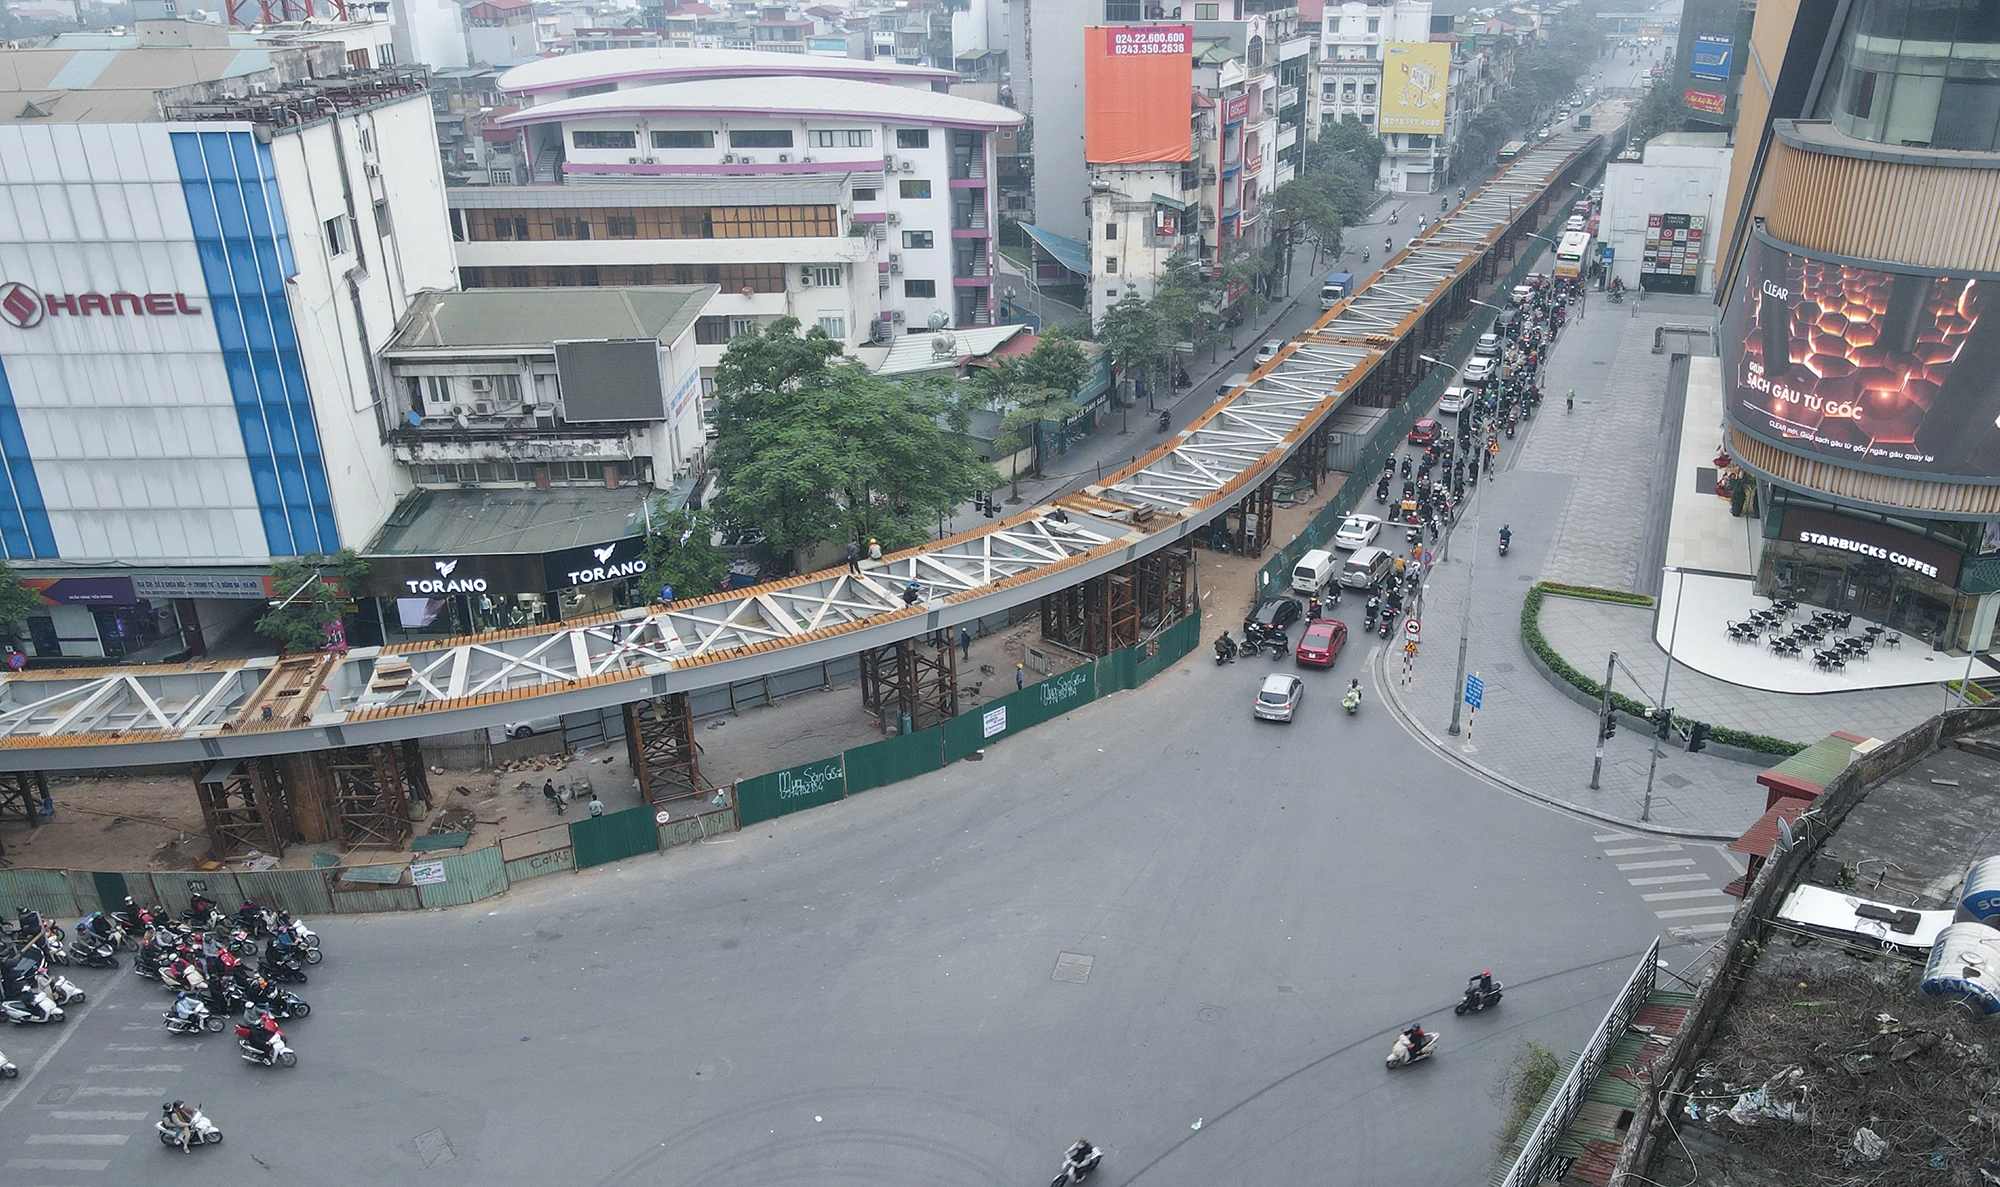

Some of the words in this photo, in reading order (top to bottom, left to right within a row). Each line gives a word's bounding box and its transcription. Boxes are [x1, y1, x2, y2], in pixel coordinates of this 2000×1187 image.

[1115, 33, 1185, 44] 024.22.600.600
[1115, 43, 1185, 54] 0243.350.2636
[1763, 279, 1789, 301] CLEAR
[45, 293, 202, 316] HANEL
[1746, 371, 1771, 394] SẠCH
[1772, 384, 1800, 404] GÀU
[1825, 400, 1864, 420] GỐC
[1769, 420, 1787, 432] CLEAR
[1904, 453, 1924, 462] quay
[1800, 531, 1888, 560] STARBUCKS
[1888, 551, 1939, 578] COFFEE
[567, 559, 648, 585] TORANO
[406, 578, 488, 594] TORANO
